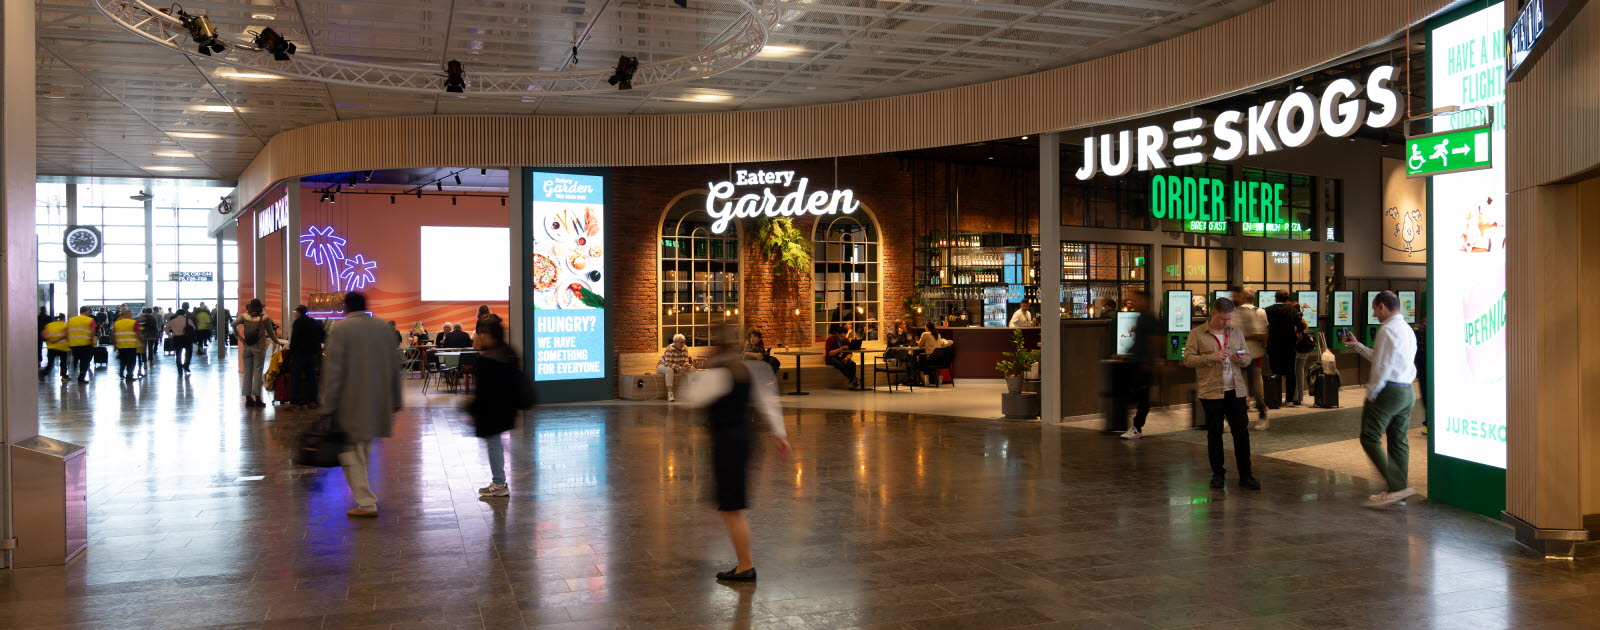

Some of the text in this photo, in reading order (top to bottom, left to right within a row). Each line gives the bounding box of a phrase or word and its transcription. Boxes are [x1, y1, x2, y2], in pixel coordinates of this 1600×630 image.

[1448, 39, 1476, 76] HAVE
[1480, 35, 1488, 65] A
[736, 170, 795, 187] Eatery
[542, 180, 594, 198] Garden
[706, 177, 861, 234] Garden
[1152, 174, 1285, 224] ORDER HERE
[537, 315, 597, 333] HUNGRY?
[537, 336, 576, 349] WE HAVE
[537, 349, 588, 362] SOMETHING
[537, 361, 601, 375] FOR EVERYONE
